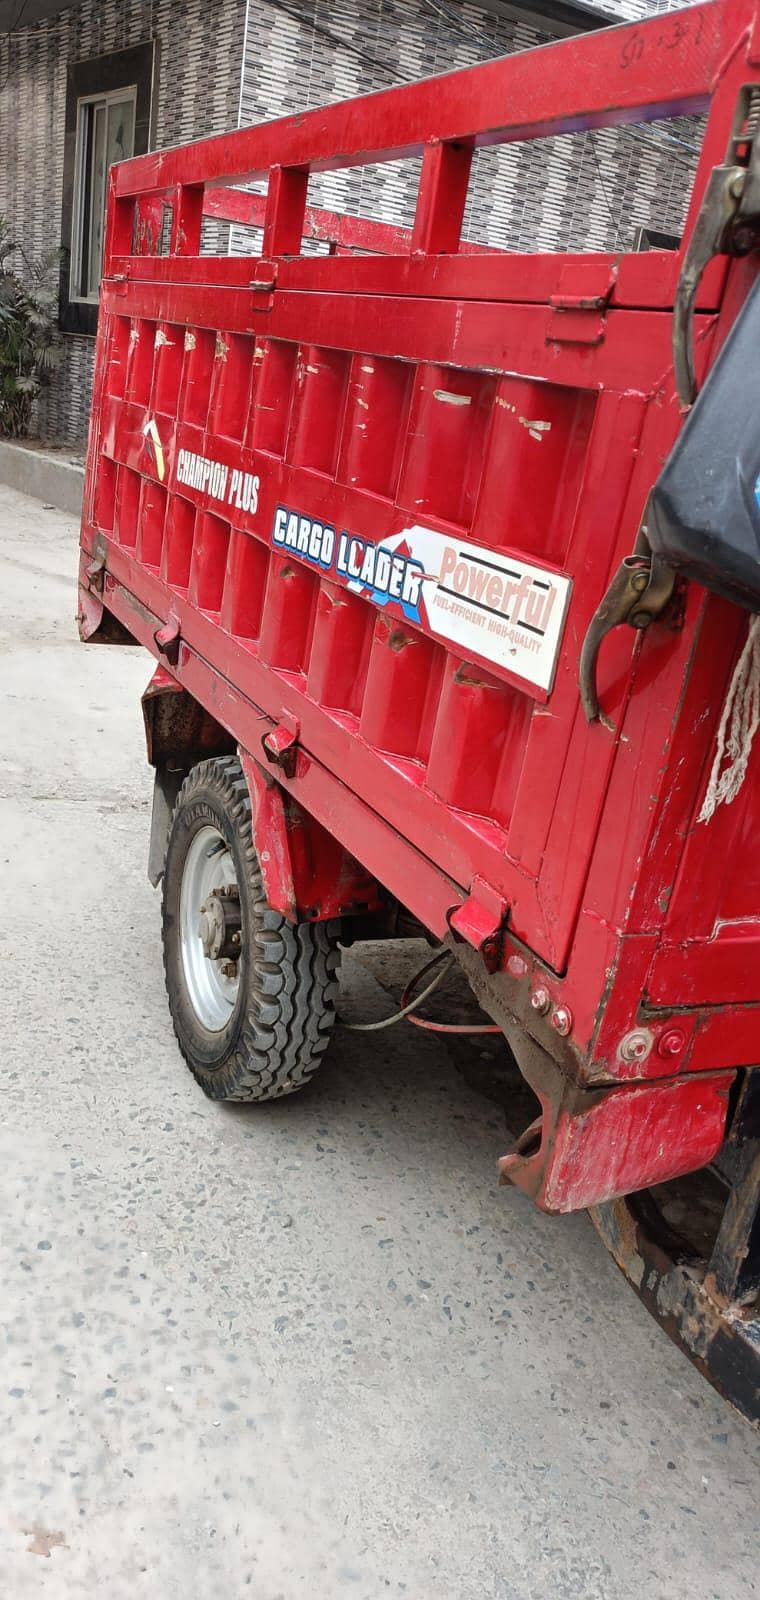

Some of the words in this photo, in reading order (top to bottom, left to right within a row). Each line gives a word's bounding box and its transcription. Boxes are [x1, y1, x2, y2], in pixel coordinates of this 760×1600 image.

[177, 448, 229, 502] CHAMPION
[228, 469, 260, 515] PLUS
[272, 507, 336, 566] CARGO
[336, 533, 424, 606] LOADER
[440, 546, 557, 631] Powerful
[432, 594, 487, 628] FUEL-EFFICIENT
[487, 618, 542, 655] HIGH-QUALITY
